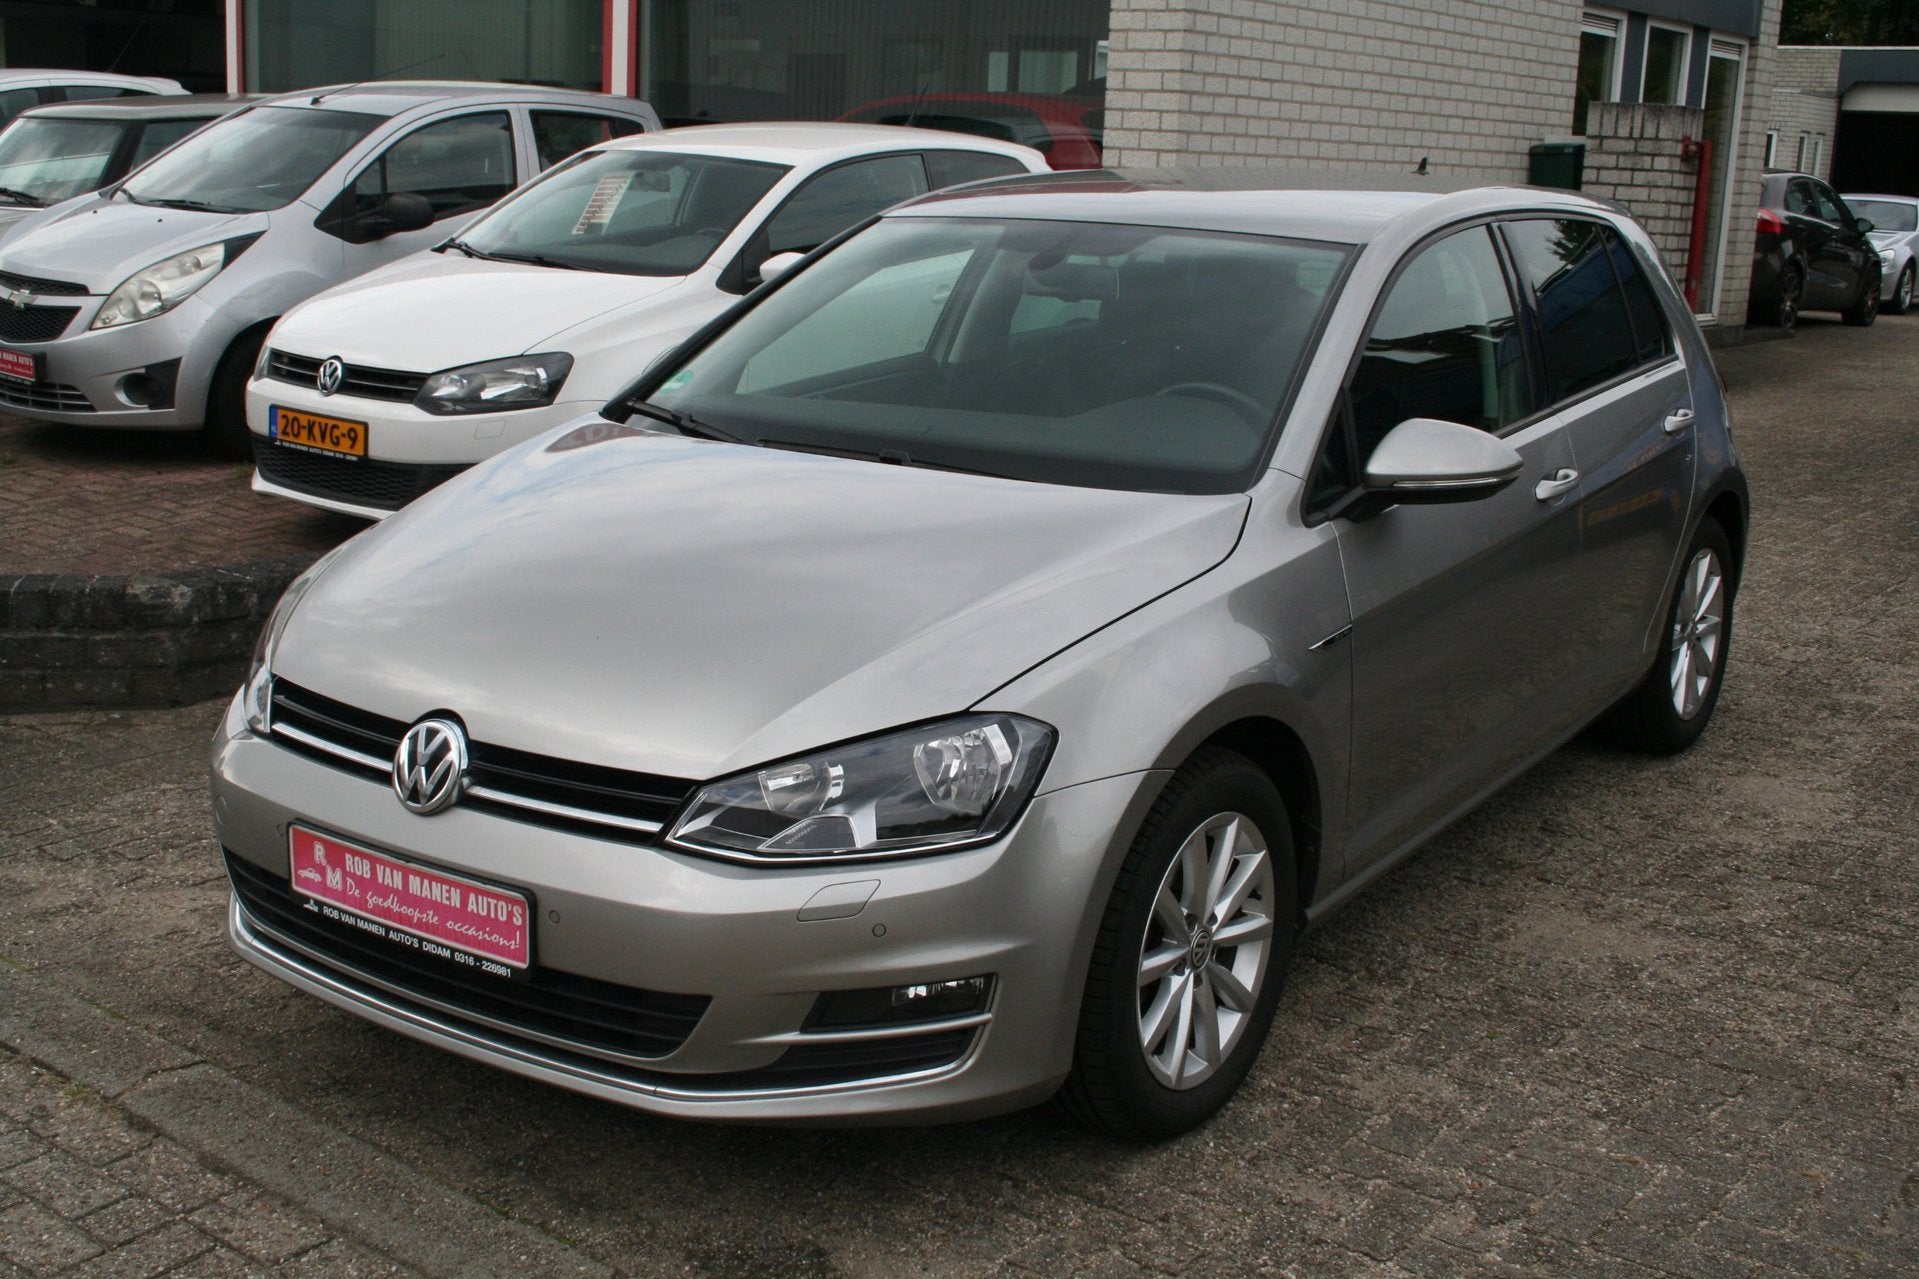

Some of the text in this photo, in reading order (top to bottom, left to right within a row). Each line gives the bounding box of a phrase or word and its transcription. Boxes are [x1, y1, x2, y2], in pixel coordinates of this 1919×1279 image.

[281, 414, 358, 449] 20-KVG-9
[345, 853, 523, 926] ROB VAN MANEN AUTO'S
[346, 877, 360, 898] De
[323, 906, 340, 920] ROB
[340, 912, 356, 926] VAN
[357, 918, 386, 937] MANEN
[388, 930, 419, 948] AUTO'S
[422, 941, 451, 959] DIDAM
[454, 952, 475, 966] 0316
